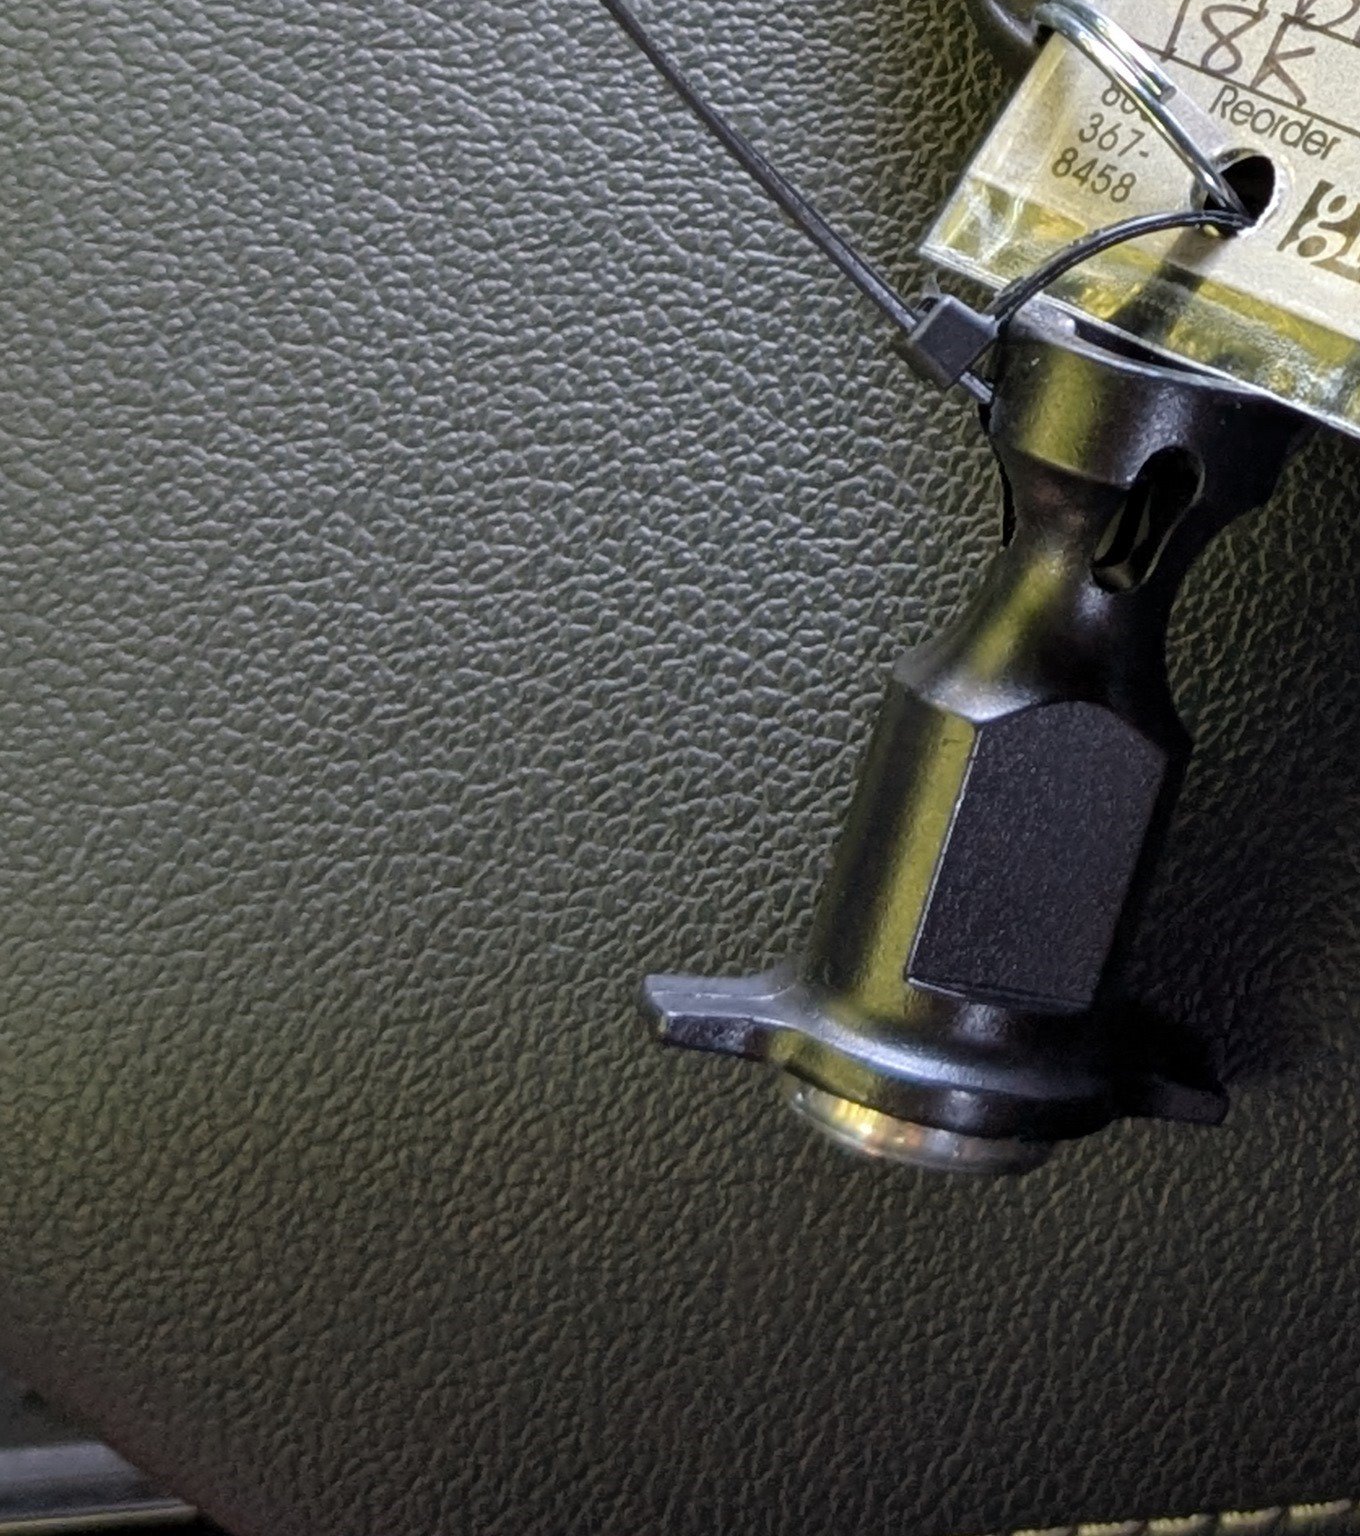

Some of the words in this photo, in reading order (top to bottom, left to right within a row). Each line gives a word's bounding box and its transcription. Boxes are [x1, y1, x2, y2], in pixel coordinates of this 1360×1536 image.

[1078, 111, 1150, 163] 367-
[1208, 85, 1342, 162] Reorder
[1050, 146, 1138, 205] 8458
